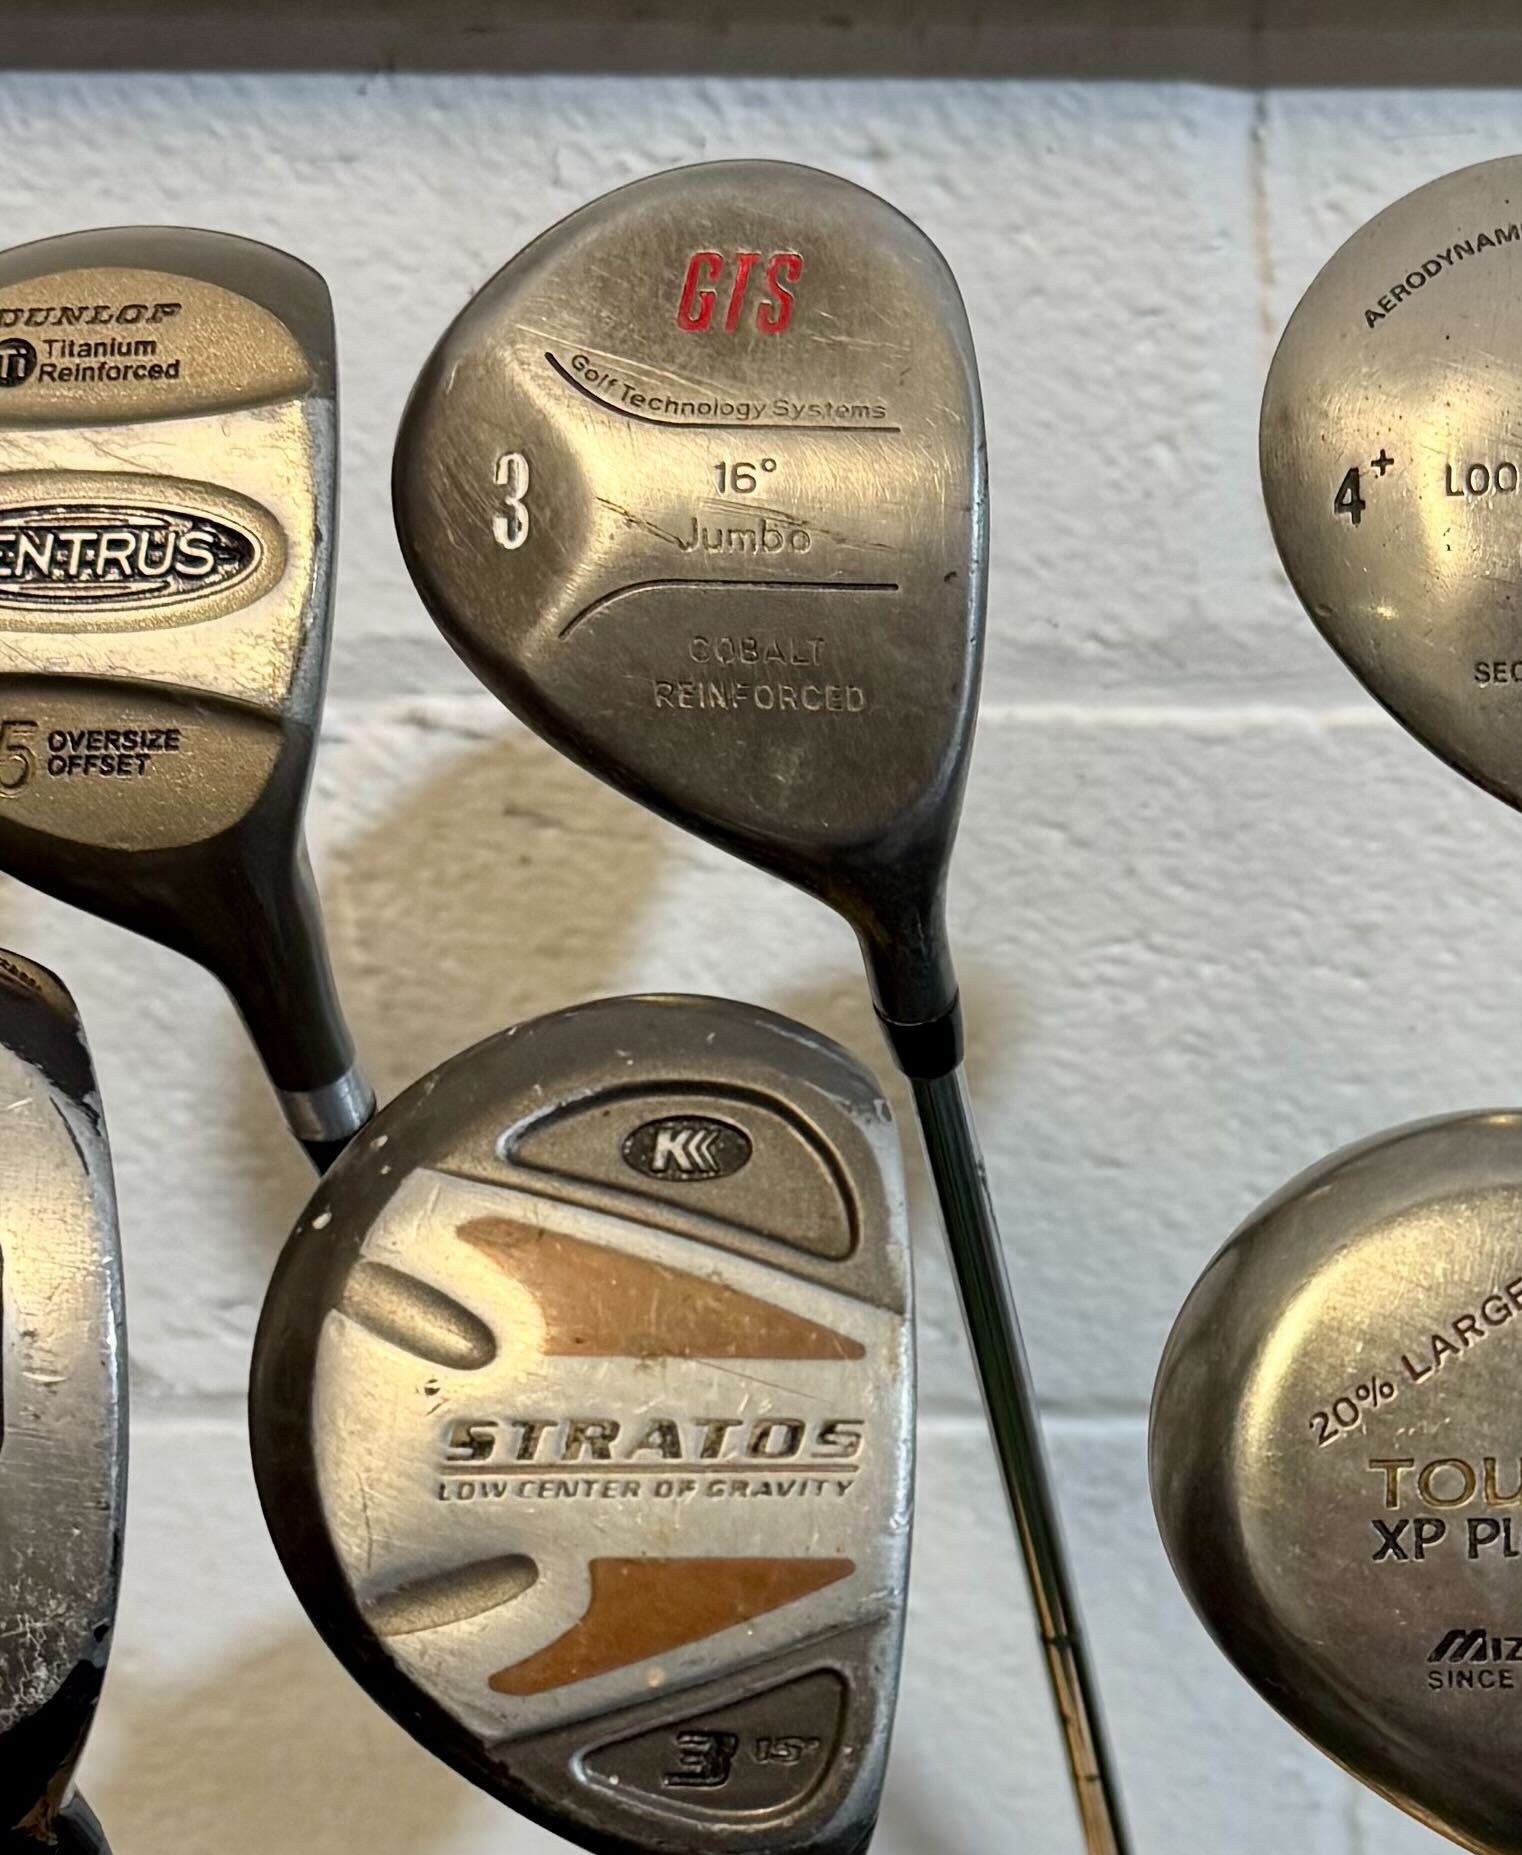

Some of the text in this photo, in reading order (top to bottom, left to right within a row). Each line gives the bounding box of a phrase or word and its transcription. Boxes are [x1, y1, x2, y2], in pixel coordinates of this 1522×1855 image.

[675, 250, 804, 335] GTS
[0, 302, 183, 328] DUNLOP
[42, 338, 158, 358] Titanium
[38, 359, 181, 384] Reinforced
[570, 352, 888, 422] Golf Technology Systems
[712, 457, 779, 496] 16°
[492, 452, 530, 551] 3
[682, 516, 813, 555] Jumbo
[689, 635, 827, 668] COBALT
[653, 679, 866, 713] REINFORCED
[0, 719, 39, 797] 5
[48, 728, 181, 752] OVERSIZE
[48, 753, 152, 777] OFFSET
[1308, 1375, 1397, 1448] 20%
[445, 1416, 866, 1463] STRATOS
[438, 1478, 856, 1501] LOW CENTER OF GRAVITY
[1370, 1517, 1448, 1562] XP
[1427, 1668, 1516, 1690] SINCE
[660, 1729, 739, 1788] 3
